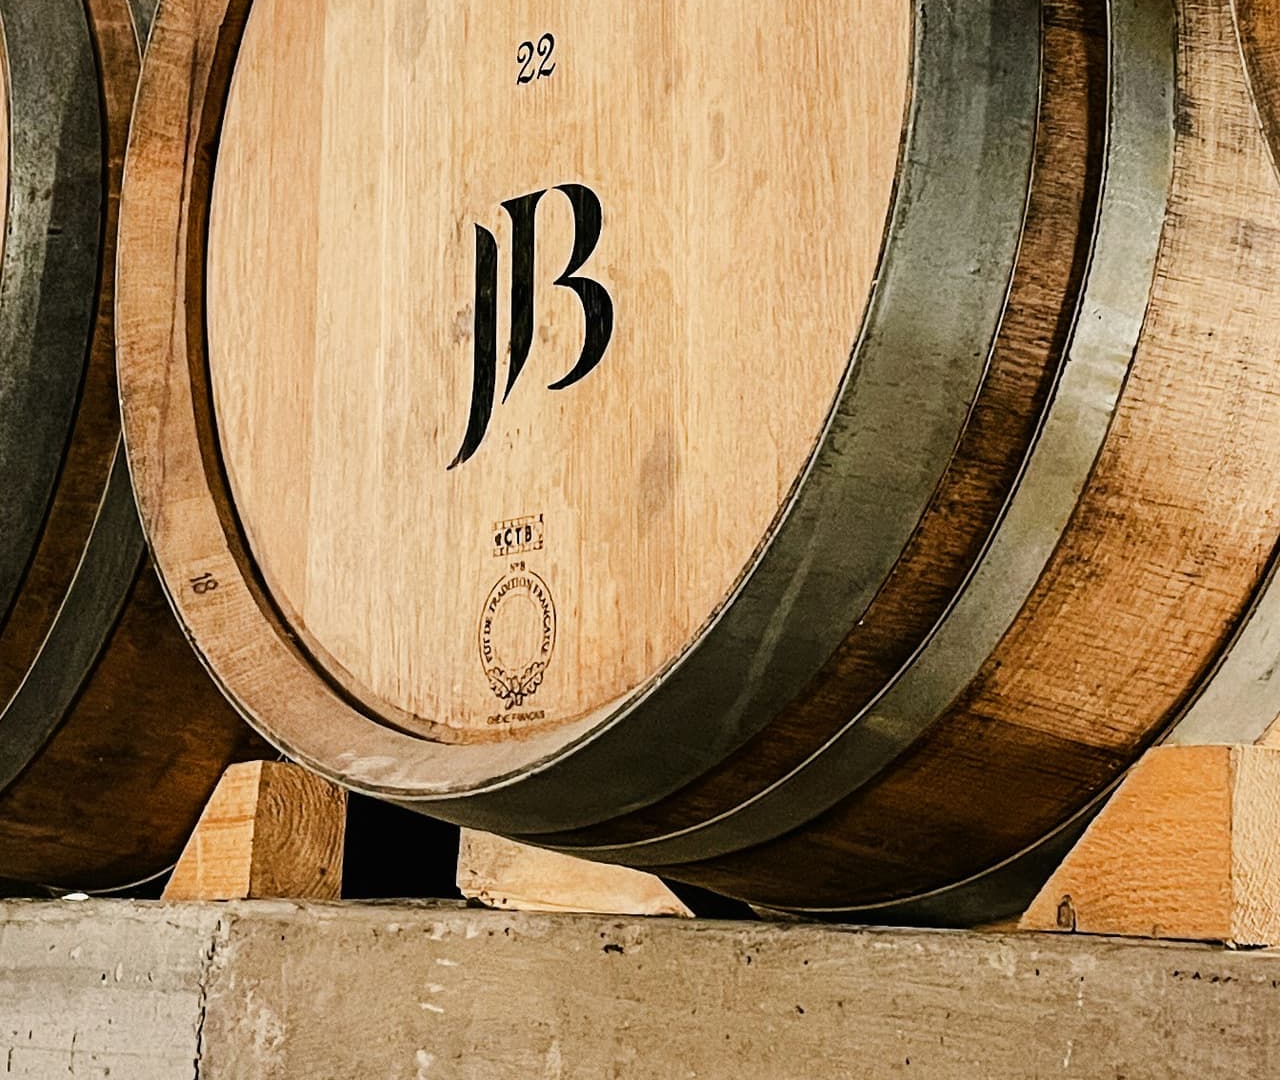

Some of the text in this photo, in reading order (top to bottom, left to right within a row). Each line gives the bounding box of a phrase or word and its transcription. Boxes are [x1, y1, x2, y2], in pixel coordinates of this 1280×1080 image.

[516, 32, 556, 85] 22
[446, 183, 614, 471] JB
[189, 572, 219, 595] 18
